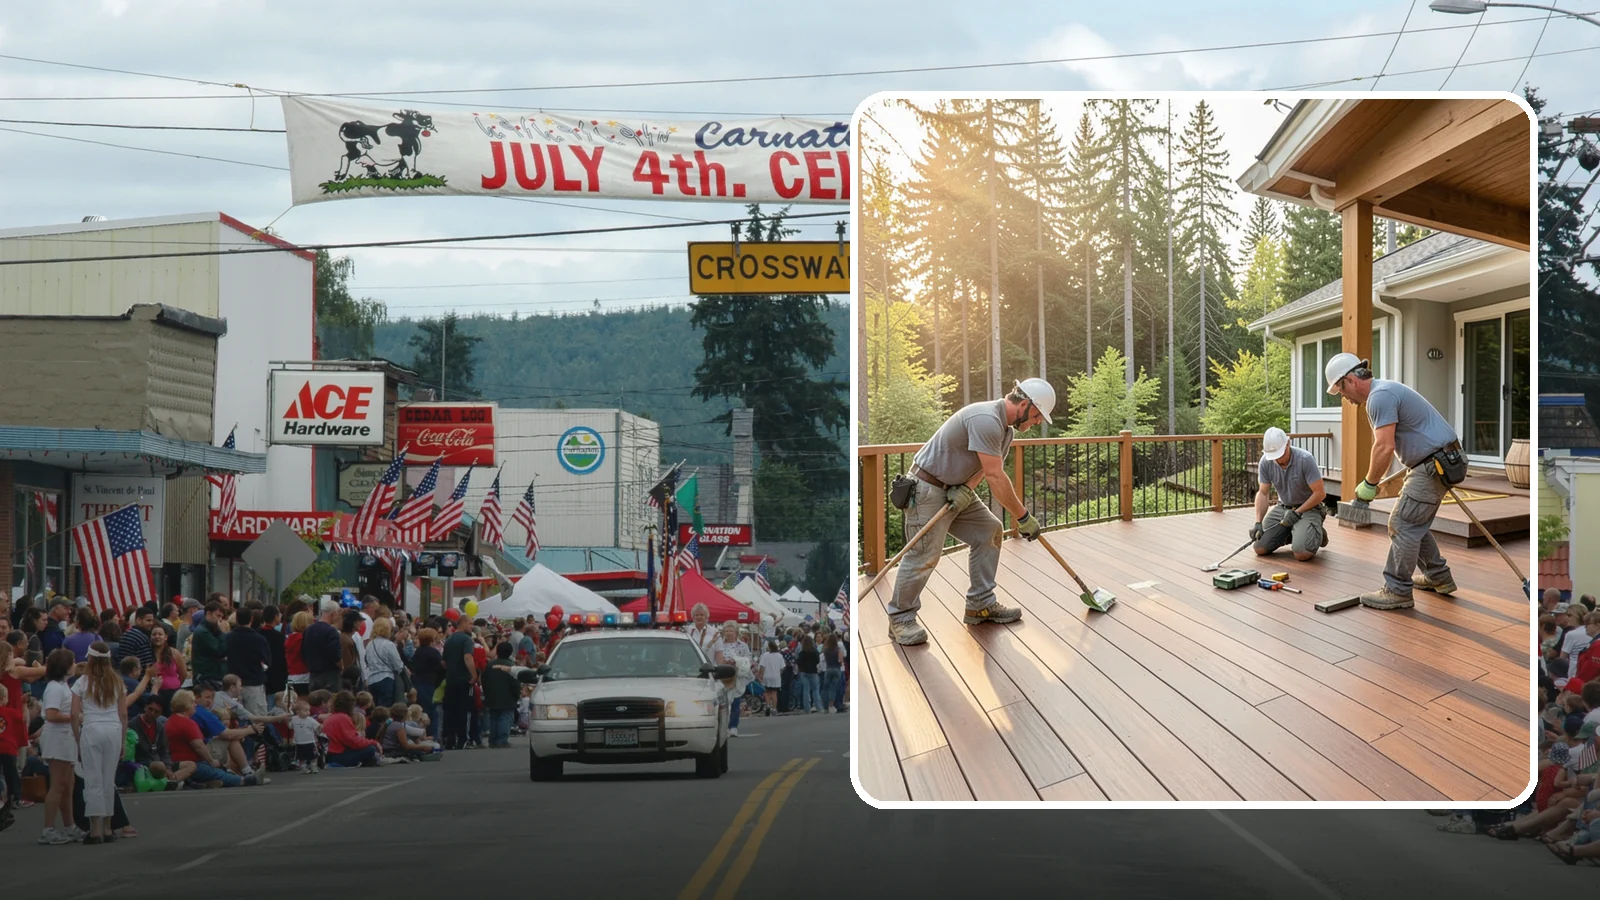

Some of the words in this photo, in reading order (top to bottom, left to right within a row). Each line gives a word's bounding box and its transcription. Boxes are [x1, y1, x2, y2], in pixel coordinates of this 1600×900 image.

[481, 141, 604, 192] JULY
[633, 150, 746, 197] 4th.
[697, 254, 850, 279] CROSSWA
[283, 380, 373, 419] ACE
[406, 409, 452, 421] CEDAR
[283, 421, 370, 436] Hardware
[416, 428, 477, 446] Coca-Cola
[95, 485, 124, 495] Vincent
[126, 486, 135, 494] de
[137, 485, 155, 495] Paul
[688, 526, 741, 535] CRNATION
[699, 535, 730, 543] GLASS
